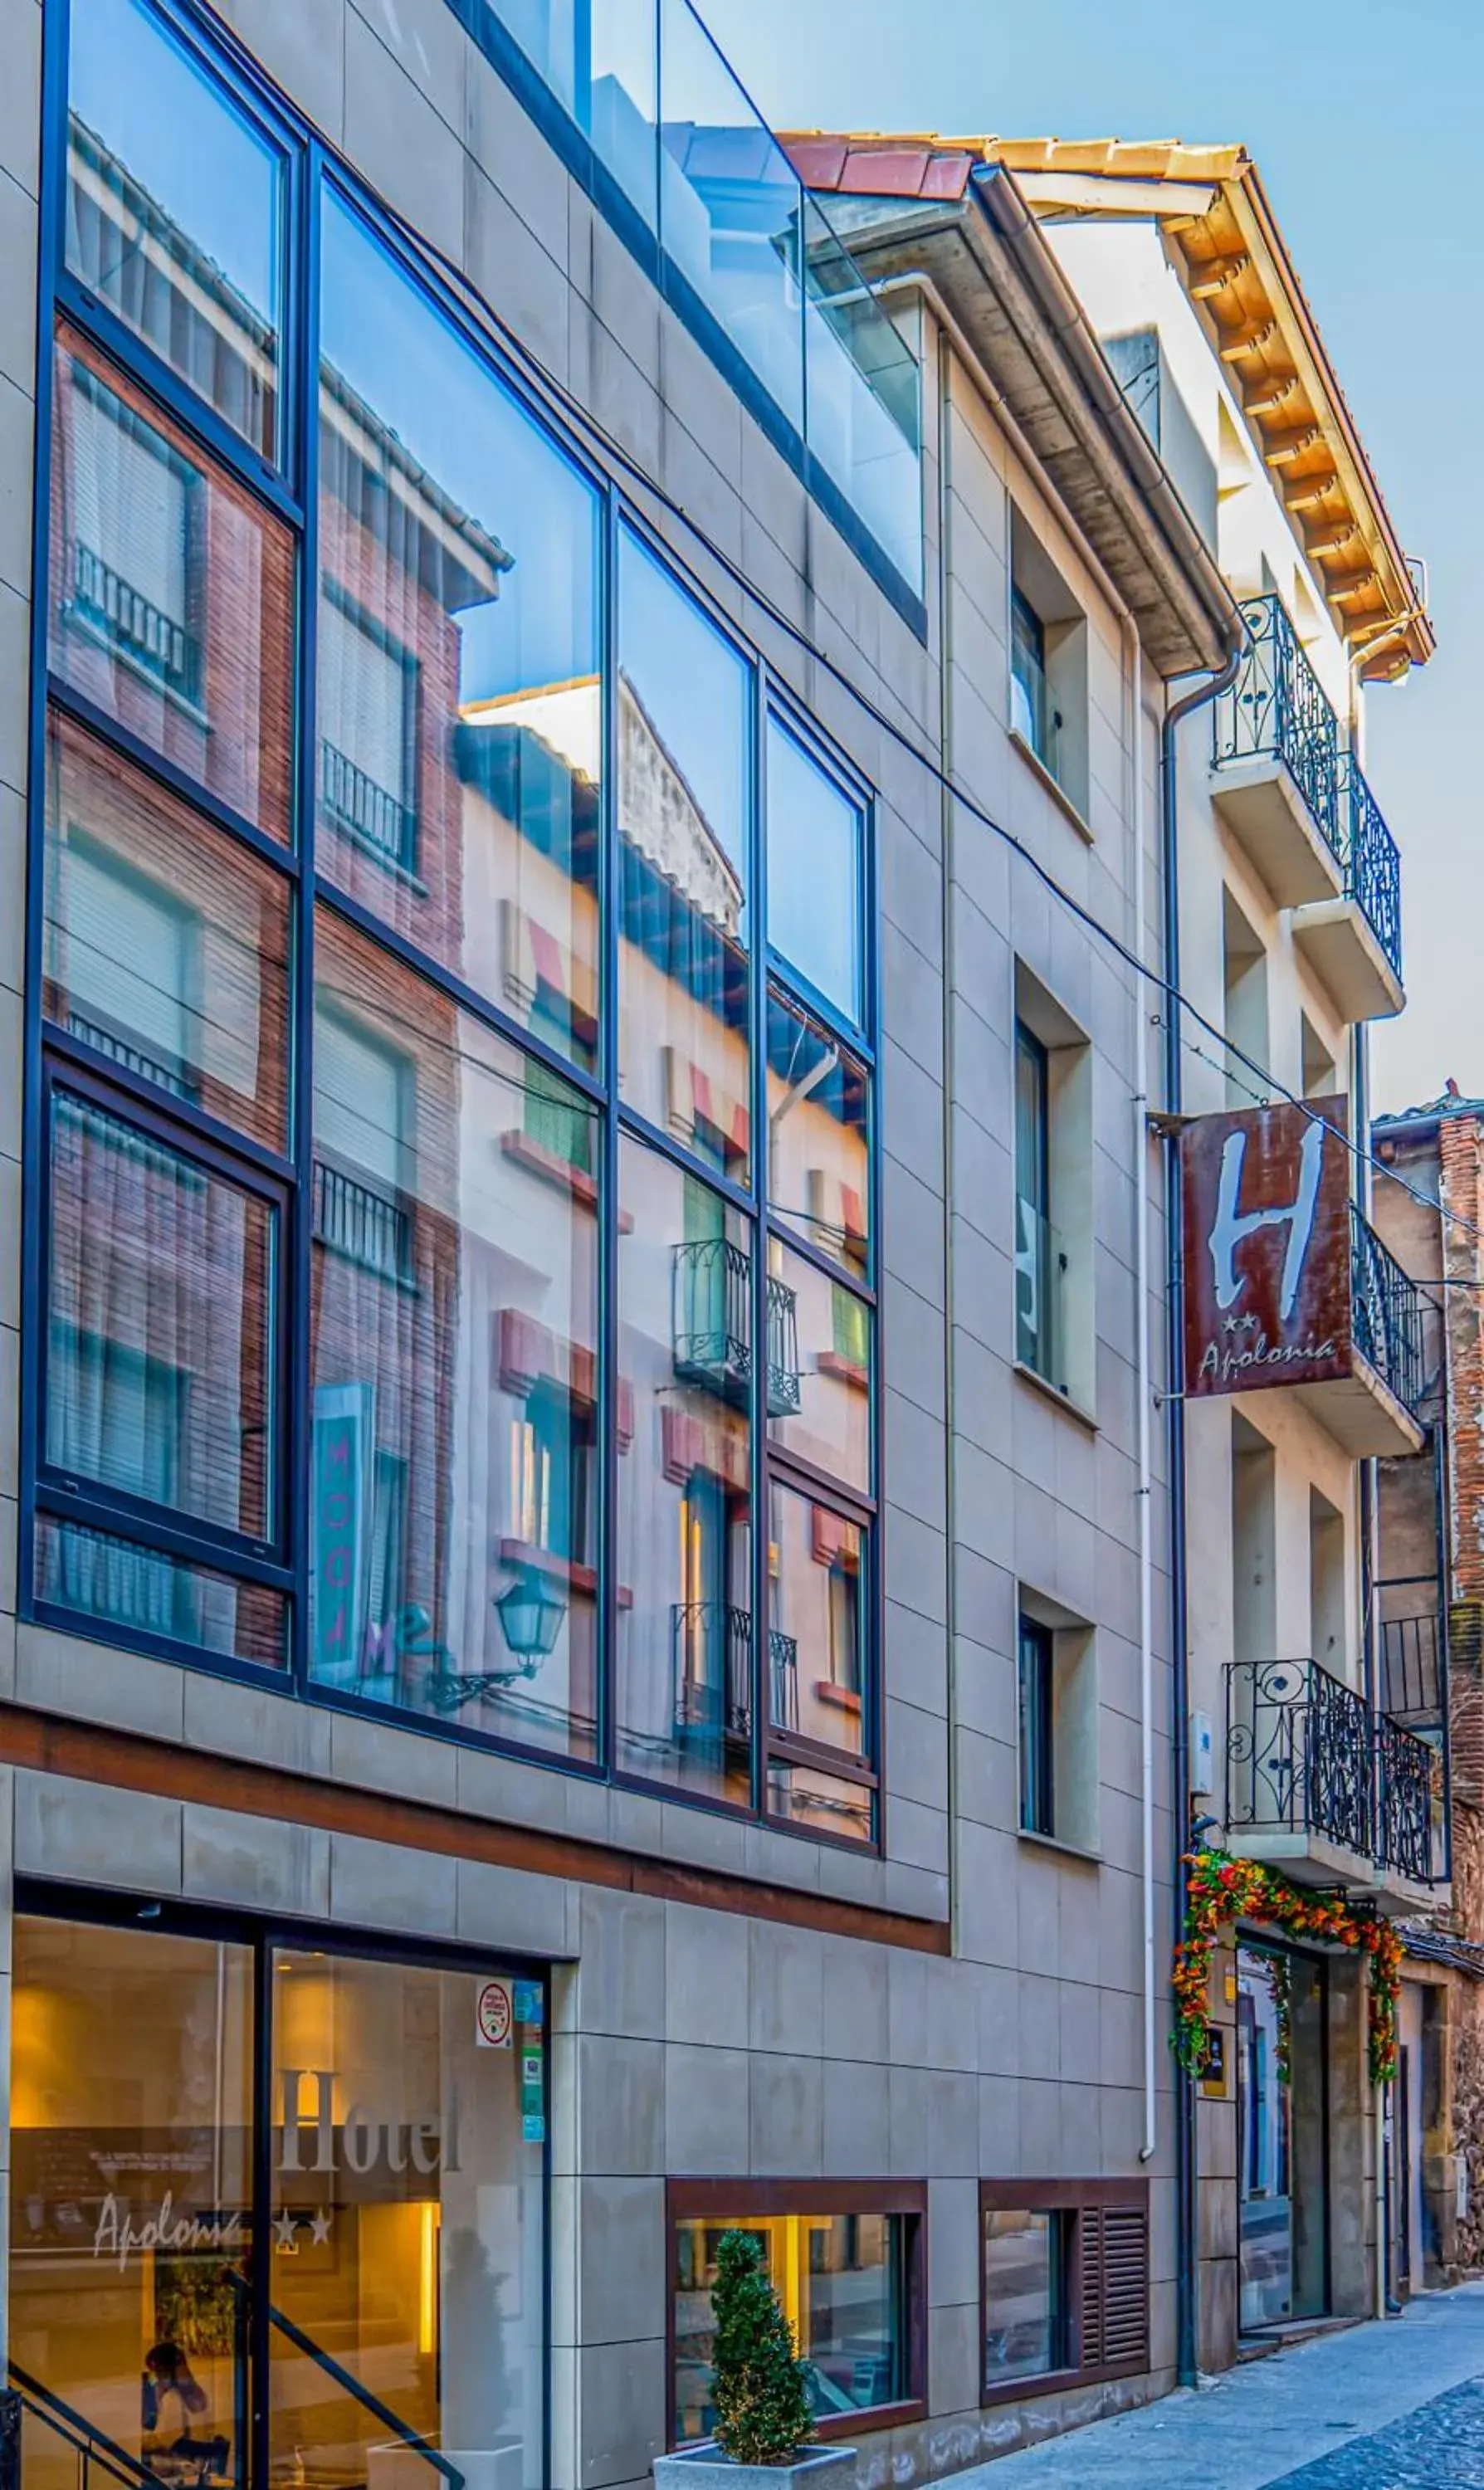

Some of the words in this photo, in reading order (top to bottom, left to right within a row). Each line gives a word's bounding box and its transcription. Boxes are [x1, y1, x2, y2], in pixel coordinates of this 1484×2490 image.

[1208, 1116, 1325, 1321] H
[1198, 1331, 1335, 1382] Apolonia
[276, 2070, 461, 2174] Hotel
